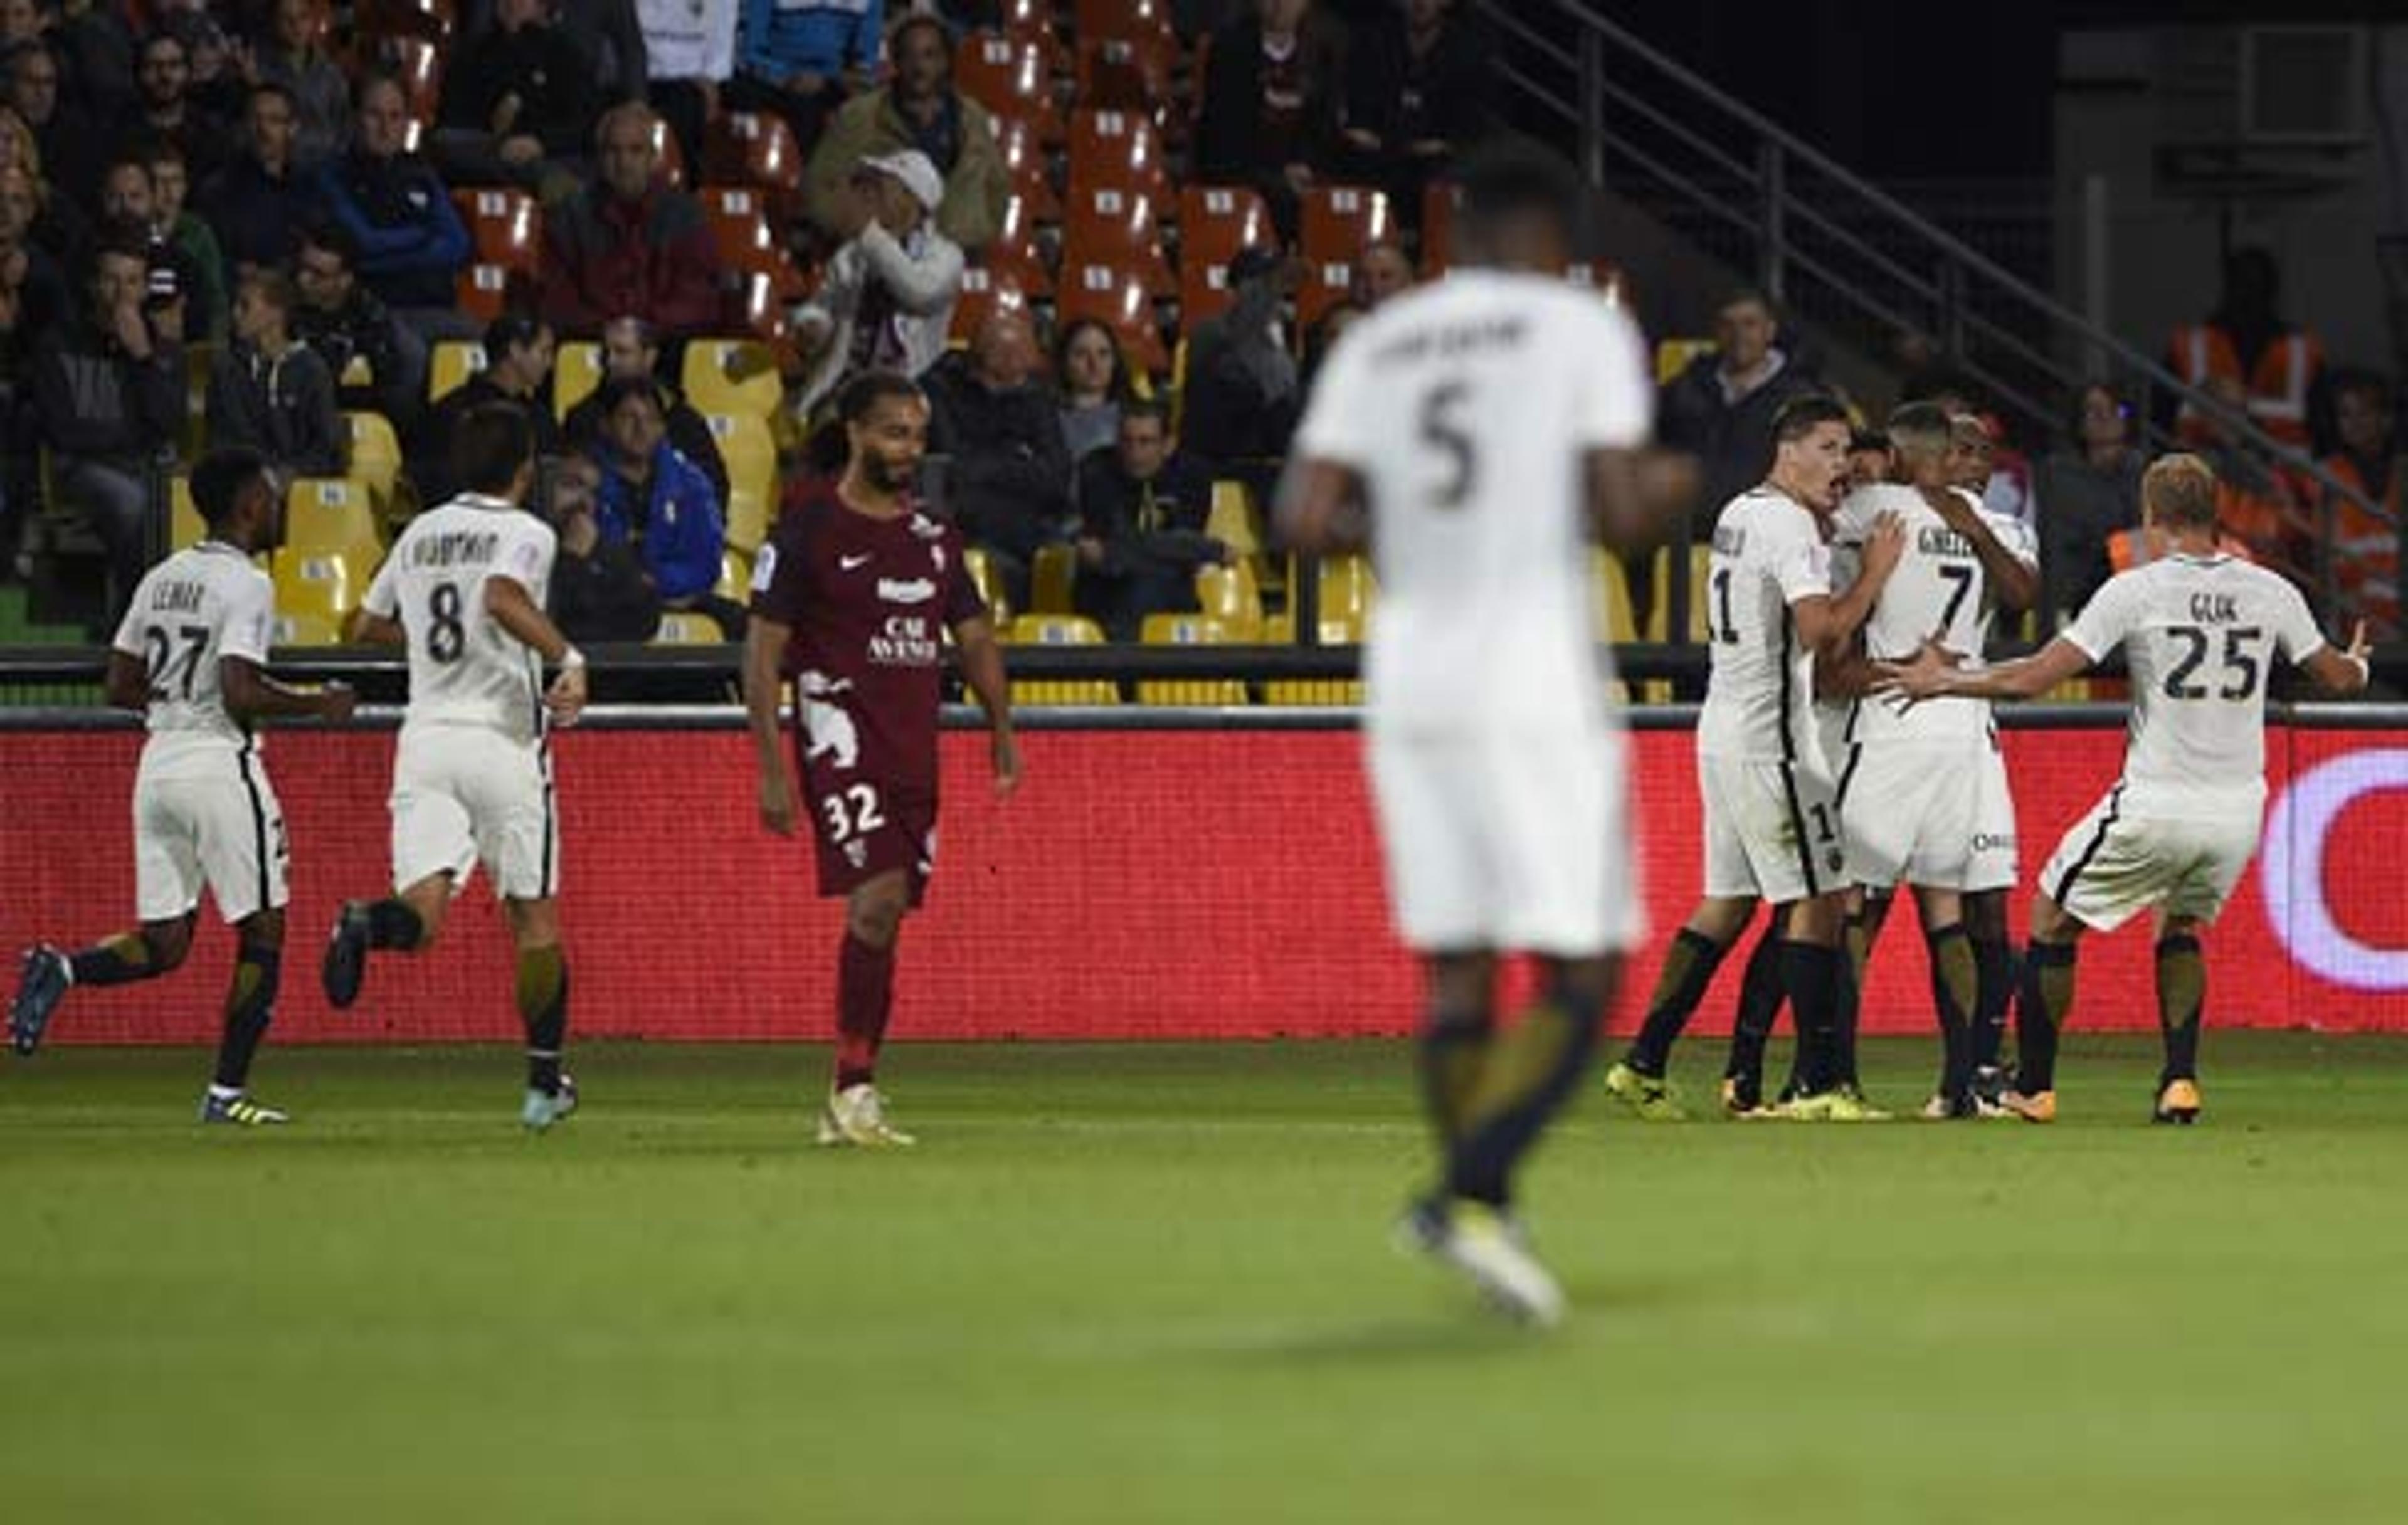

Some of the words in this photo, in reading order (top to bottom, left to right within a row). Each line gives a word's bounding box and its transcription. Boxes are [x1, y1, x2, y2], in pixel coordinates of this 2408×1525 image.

[1418, 380, 1476, 510] 5
[427, 579, 466, 666] 8
[1939, 565, 1973, 631] 7
[145, 625, 210, 702] 27
[2163, 626, 2261, 702] 25
[823, 784, 885, 842] 32
